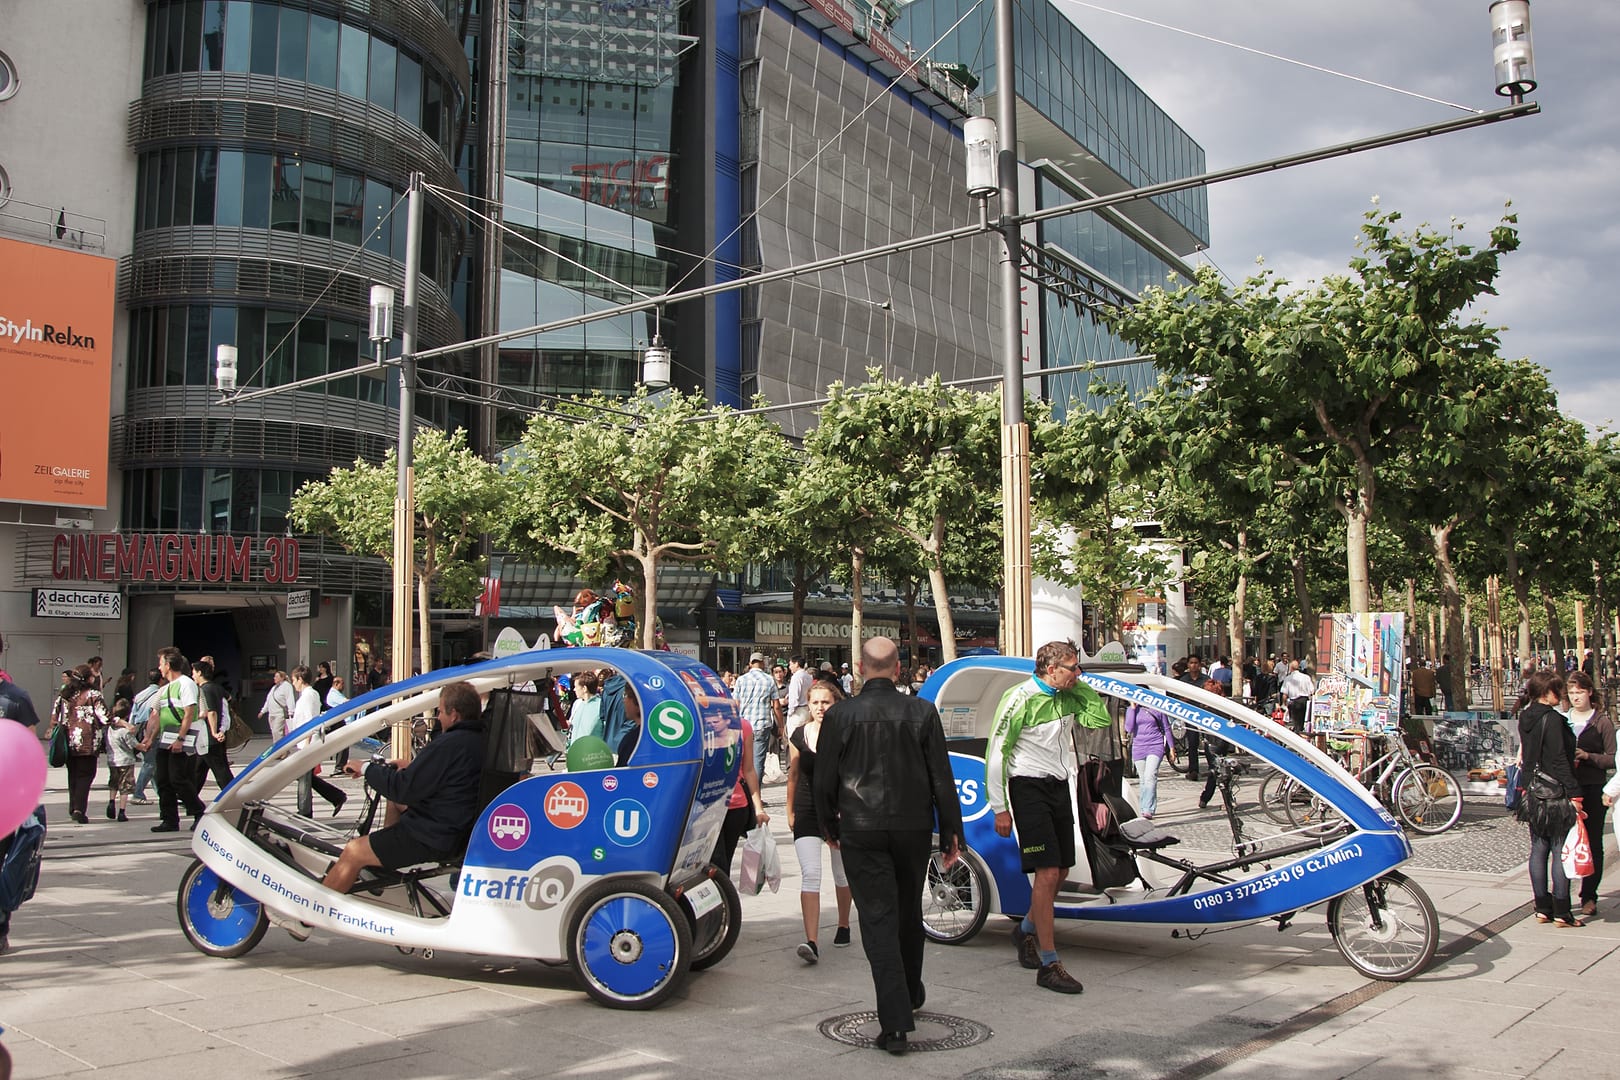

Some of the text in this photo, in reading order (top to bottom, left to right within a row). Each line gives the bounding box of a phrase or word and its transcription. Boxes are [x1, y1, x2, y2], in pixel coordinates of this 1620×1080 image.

[34, 464, 90, 479] ZEILGALERIE
[53, 533, 299, 584] CINEMAGNUM 3D
[49, 591, 110, 605] dachcafé
[757, 620, 793, 635] UNITE
[801, 622, 839, 638] COLORS
[1079, 674, 1222, 731] ww.fes-frankfurt.de
[657, 706, 685, 741] S
[614, 808, 640, 838] U
[201, 829, 395, 937] Busse und Bahnen in Frankfurt
[463, 873, 566, 905] traffiQ
[1193, 843, 1363, 910] 0180 3 372255-0 (9 Ct./Min.)
